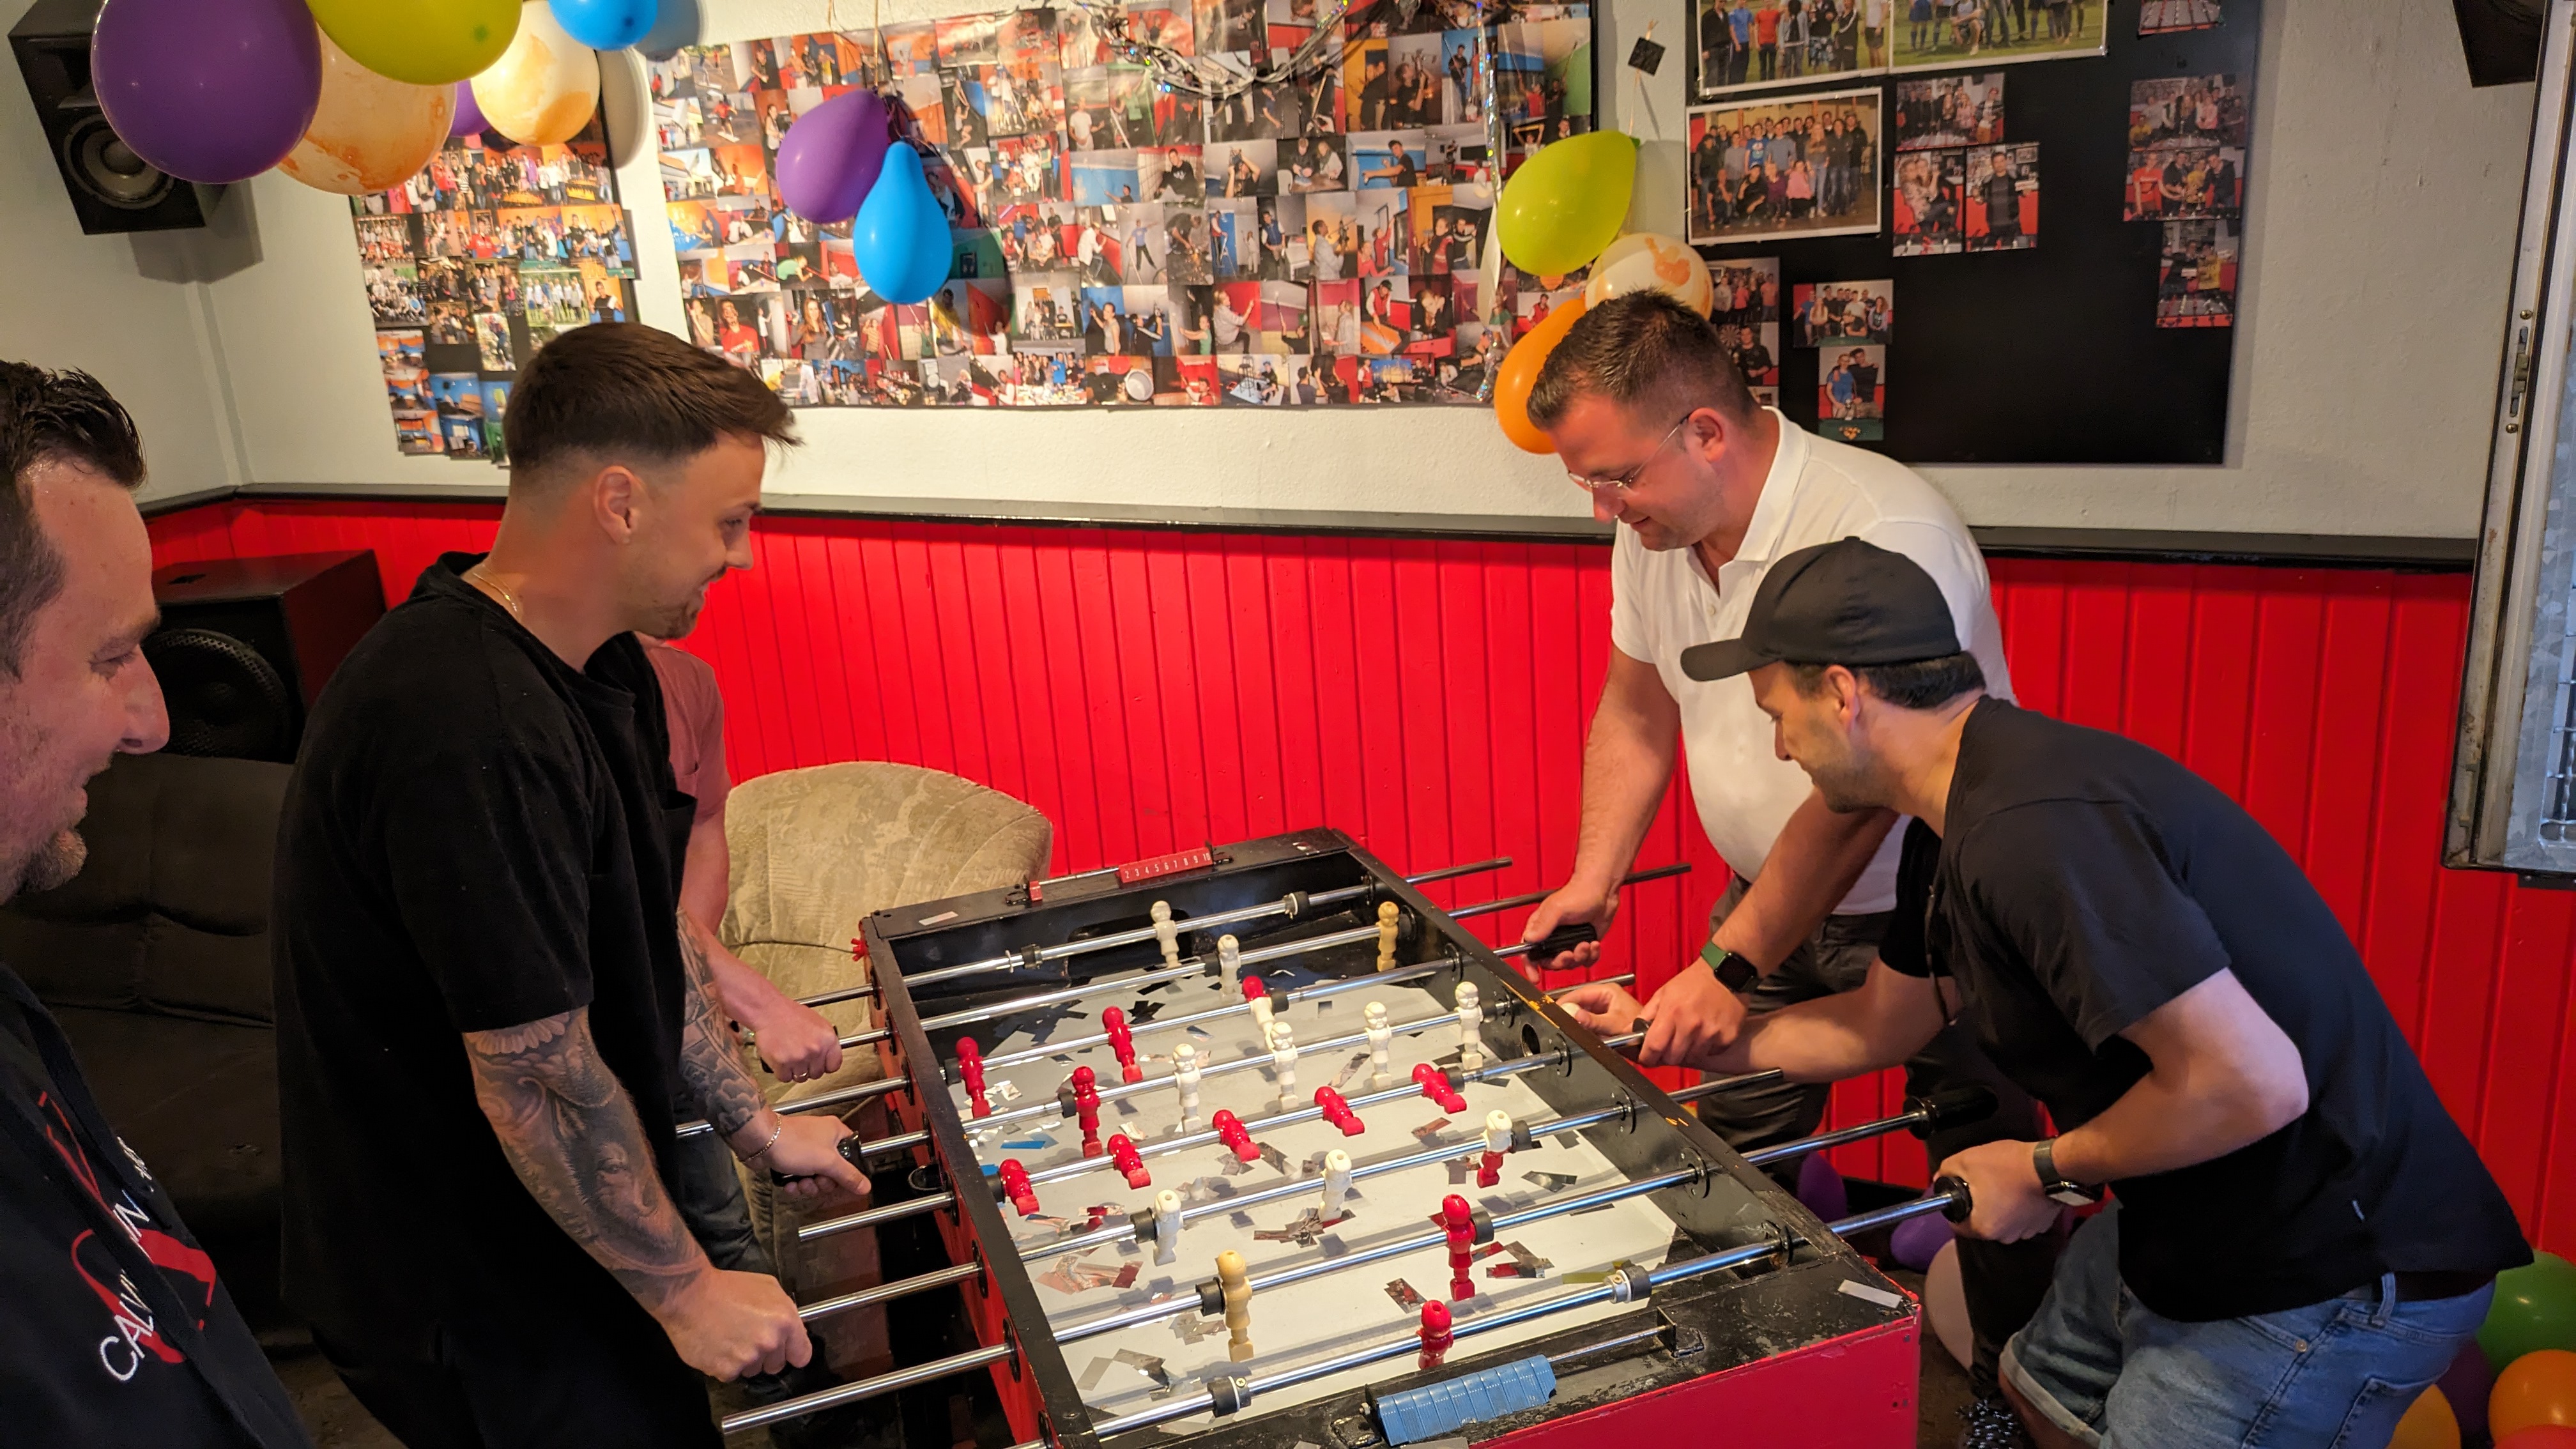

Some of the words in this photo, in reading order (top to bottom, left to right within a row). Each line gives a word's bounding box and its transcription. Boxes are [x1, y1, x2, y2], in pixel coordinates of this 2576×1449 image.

[1125, 870, 1130, 879] 2
[1135, 868, 1140, 877] 3
[1154, 864, 1160, 872] 5
[1164, 862, 1169, 870] 6
[1173, 860, 1178, 868] 7
[1183, 857, 1189, 866] 8
[1193, 855, 1199, 864] 9
[1202, 852, 1211, 861] 10
[100, 1269, 154, 1381] CALVI
